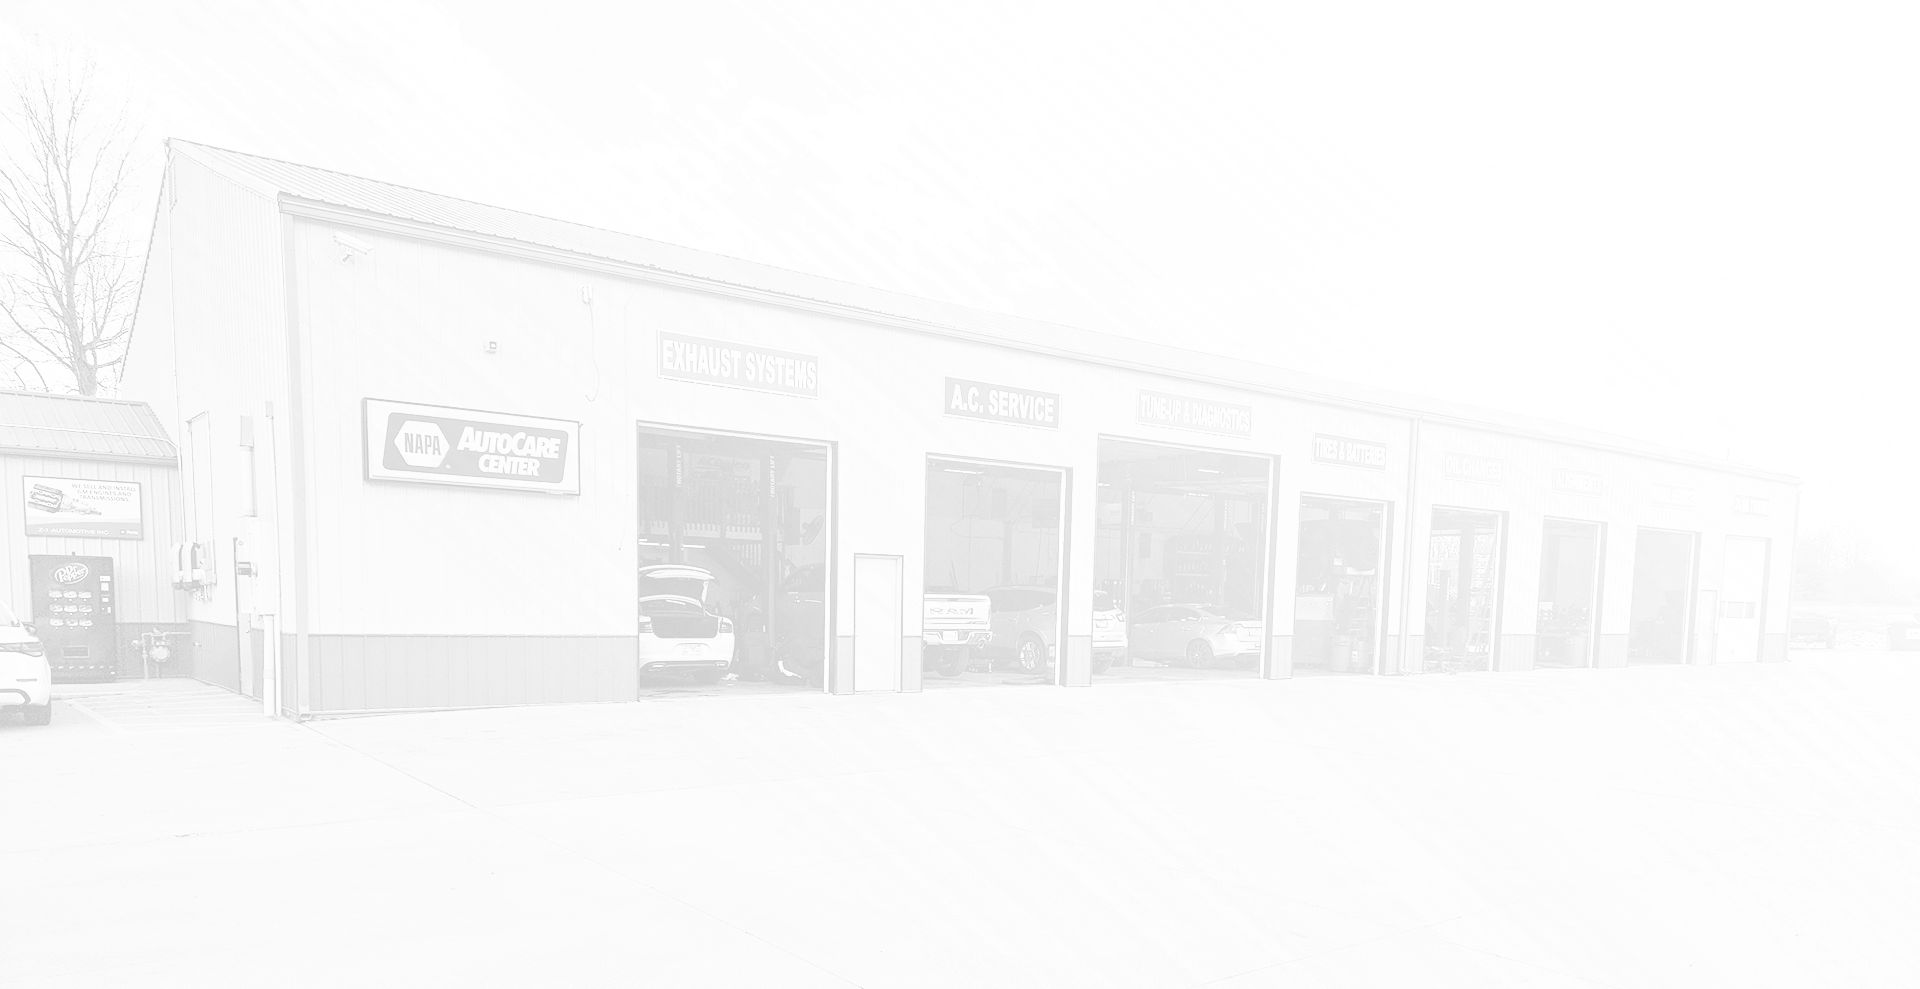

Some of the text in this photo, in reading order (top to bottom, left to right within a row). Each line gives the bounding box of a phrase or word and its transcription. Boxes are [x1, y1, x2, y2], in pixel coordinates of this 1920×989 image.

[663, 339, 817, 390] EXHAUST SYSTEMS
[951, 384, 1055, 422] A.C. SERVICE
[1140, 394, 1251, 432] TUNE-UP & DIAGNOSTICS
[404, 432, 441, 455] NAPA
[1315, 437, 1386, 467] TIRES & BATTERIES
[478, 453, 541, 477] CENTER
[1446, 454, 1503, 480] OIL CHANGES
[58, 567, 86, 582] Pepper
[65, 565, 78, 573] Dr
[929, 607, 974, 615] RAM
